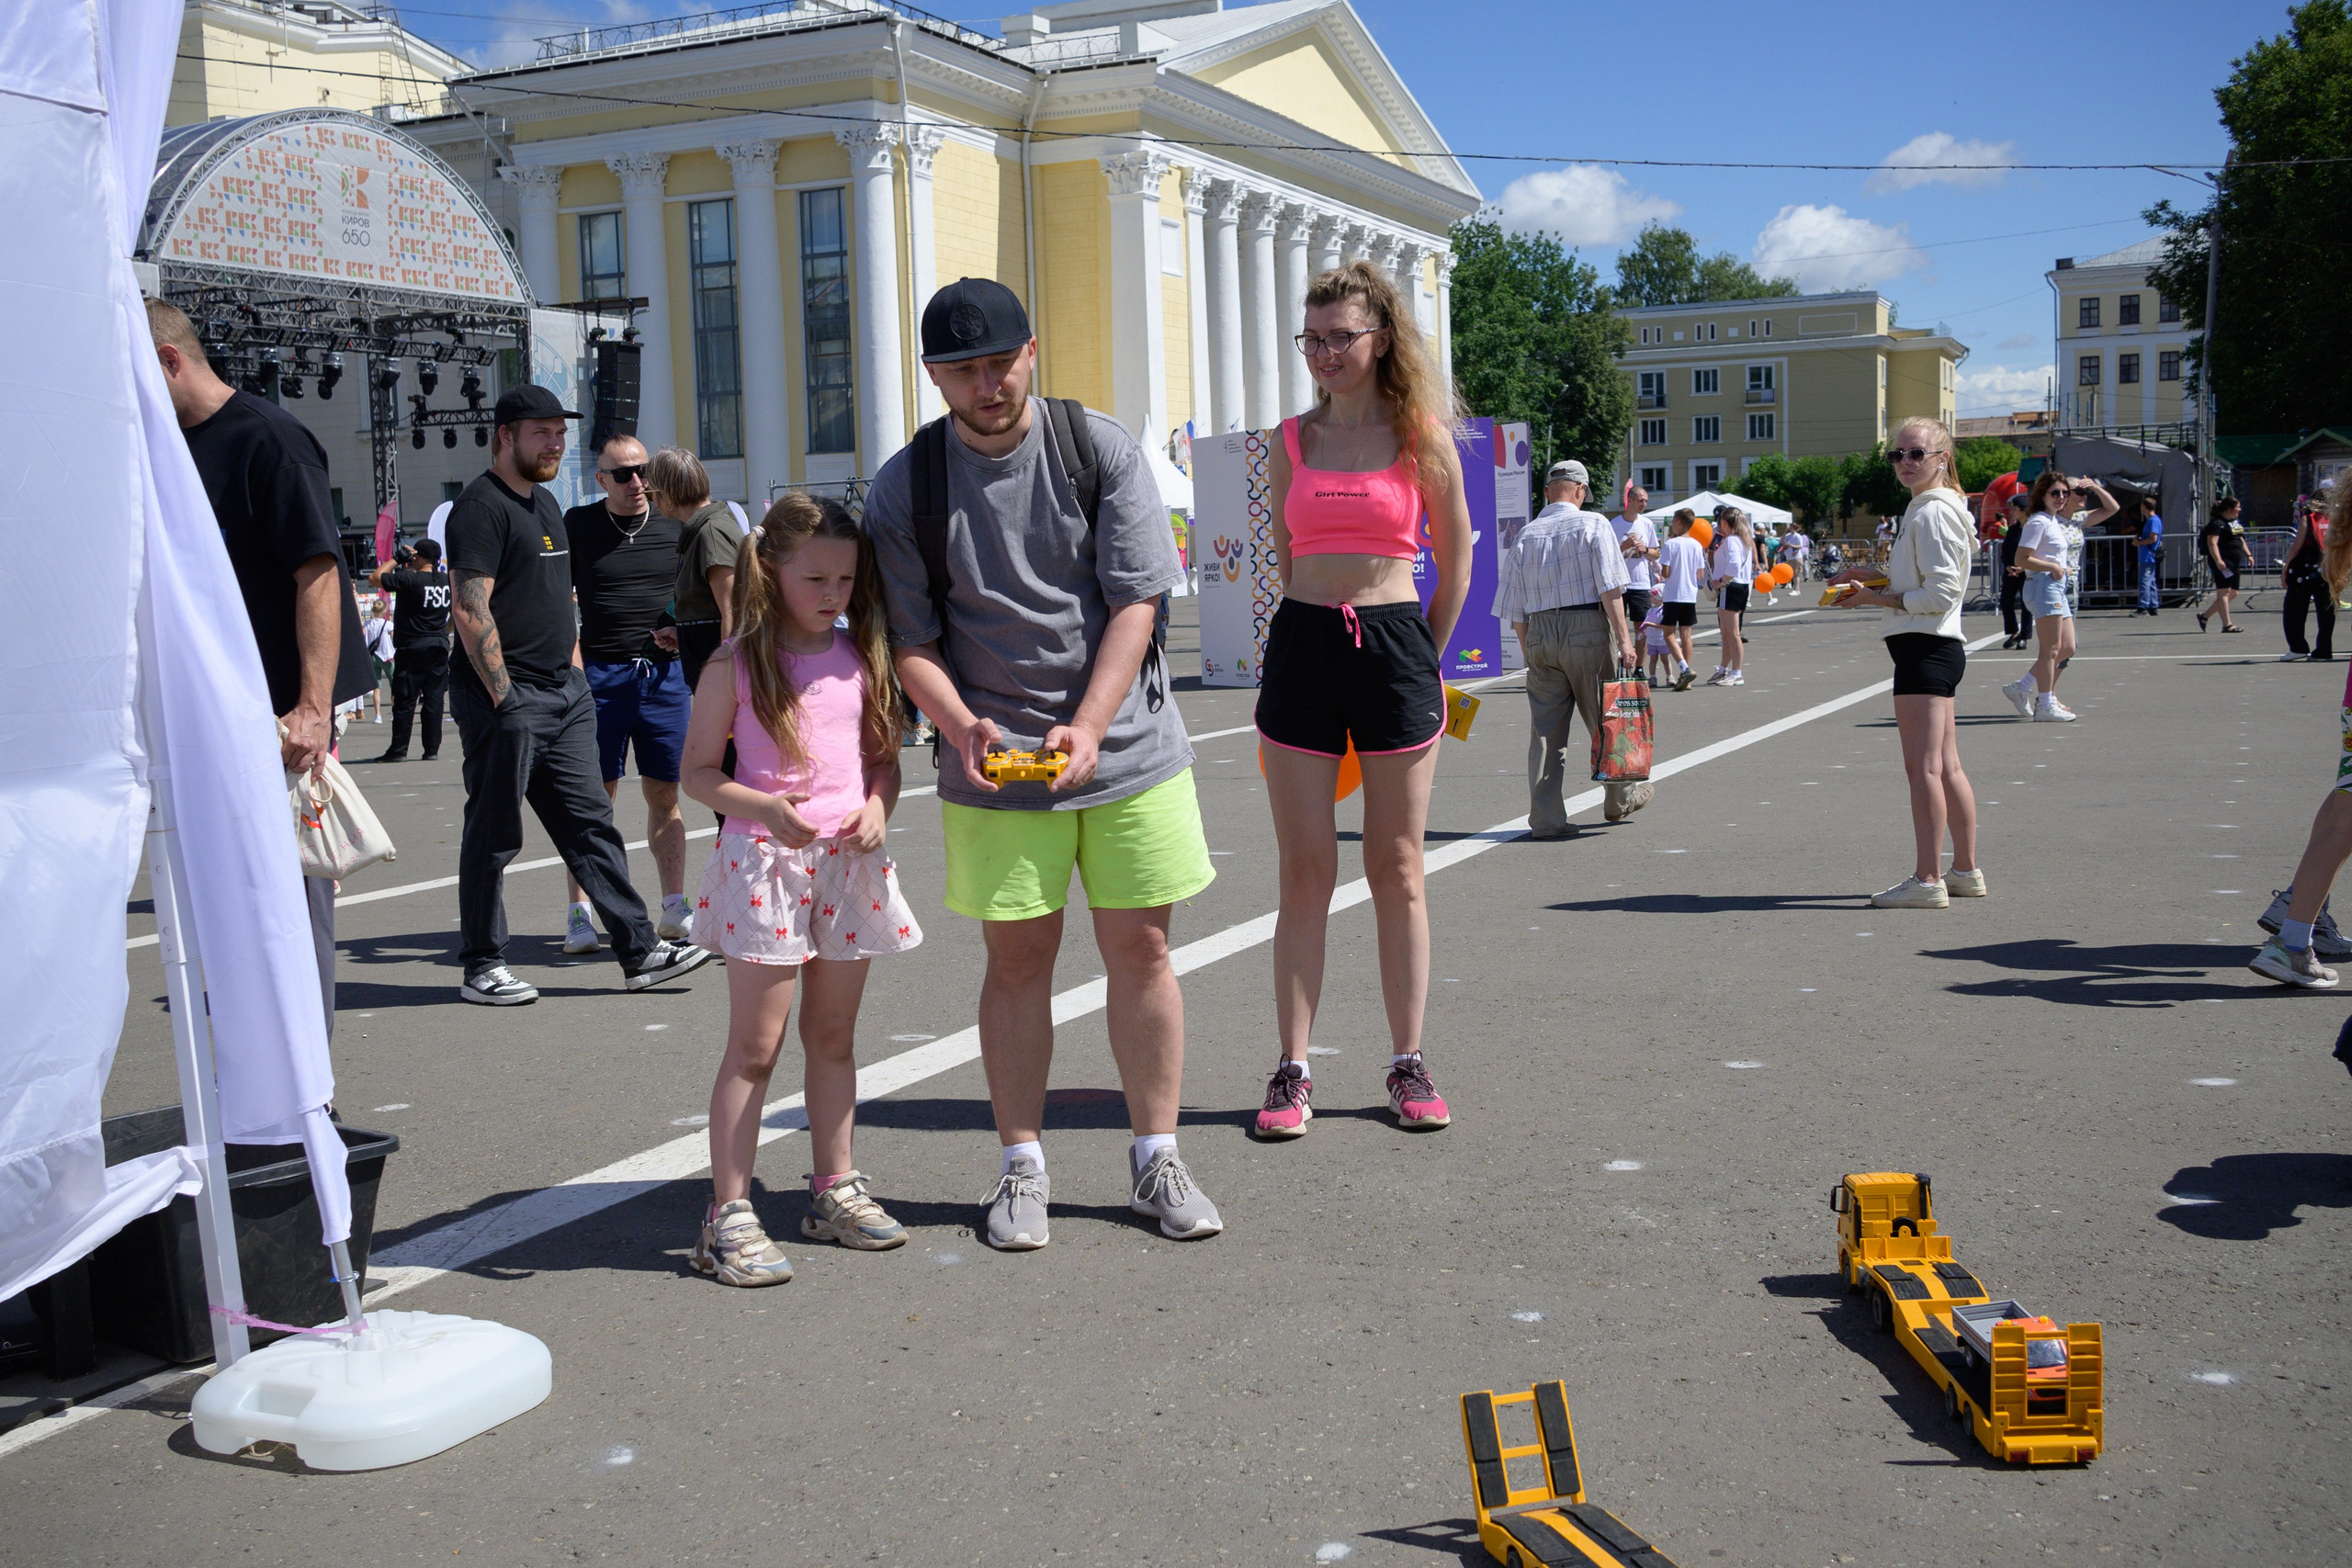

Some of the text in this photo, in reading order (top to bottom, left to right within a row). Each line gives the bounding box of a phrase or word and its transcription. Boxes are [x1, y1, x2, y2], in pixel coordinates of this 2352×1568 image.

[341, 215, 370, 229] КИРОВ
[342, 228, 371, 247] 650
[1204, 562, 1220, 571] ЖИВИ
[1204, 573, 1220, 582] ЯРКО!
[423, 585, 450, 608] FSC
[1455, 662, 1488, 671] ПРОФСТРОЙ
